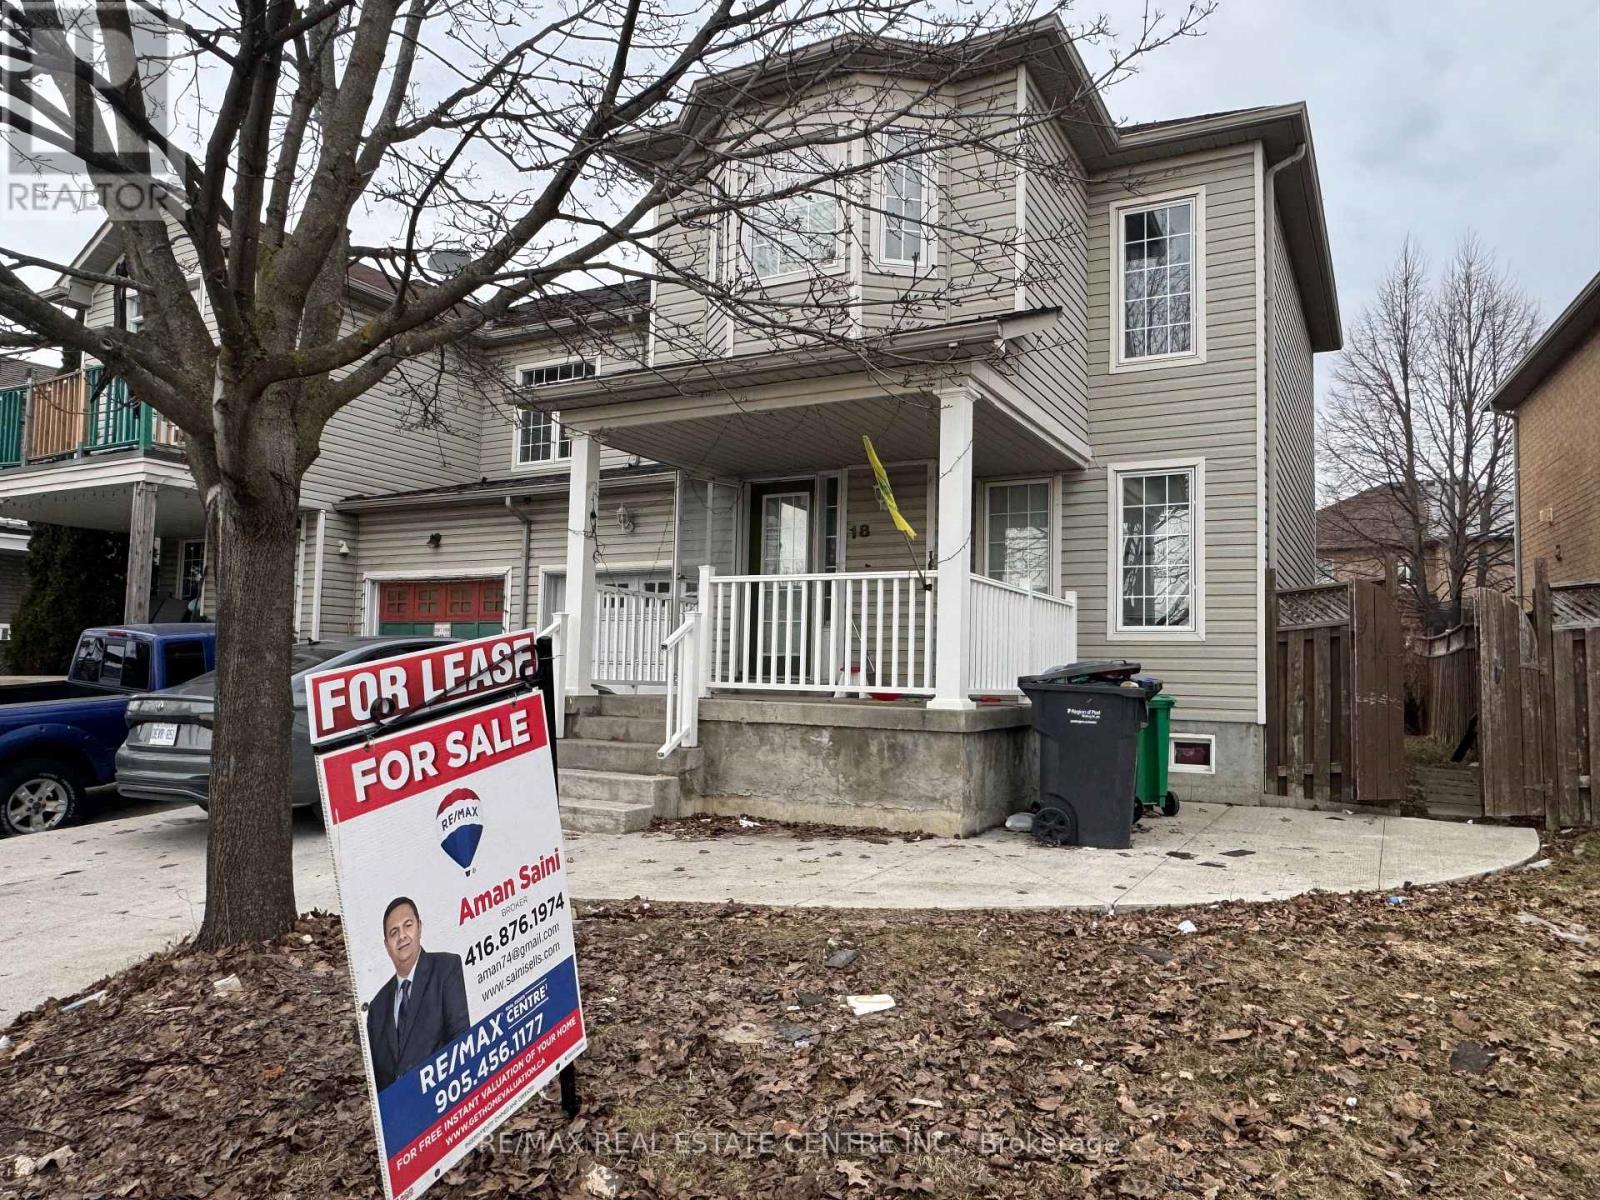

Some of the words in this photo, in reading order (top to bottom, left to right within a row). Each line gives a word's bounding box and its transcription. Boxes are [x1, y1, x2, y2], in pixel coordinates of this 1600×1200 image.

[848, 524, 870, 539] 18
[318, 665, 409, 731] FOR
[351, 740, 439, 803] FOR
[445, 710, 531, 769] SALE
[440, 806, 478, 832] RE/MAX
[459, 878, 515, 926] Aman
[519, 848, 561, 889] Saini
[501, 895, 528, 918] BROKER
[464, 891, 565, 967] 416.876.1974
[476, 922, 561, 984] aman74@gmail.com
[481, 941, 561, 1003] www.sainisells.com
[419, 1014, 504, 1095] RE/MAX
[506, 986, 546, 1023] CENTRE
[434, 1013, 544, 1114] 905.456.1177
[396, 1149, 418, 1171] FOR
[418, 1127, 443, 1153] FREE
[444, 1095, 480, 1132] INSTANT
[481, 1061, 525, 1099] VALUATION
[525, 1049, 537, 1064] OF
[536, 1034, 558, 1055] YOUR
[556, 1016, 577, 1039] HOME
